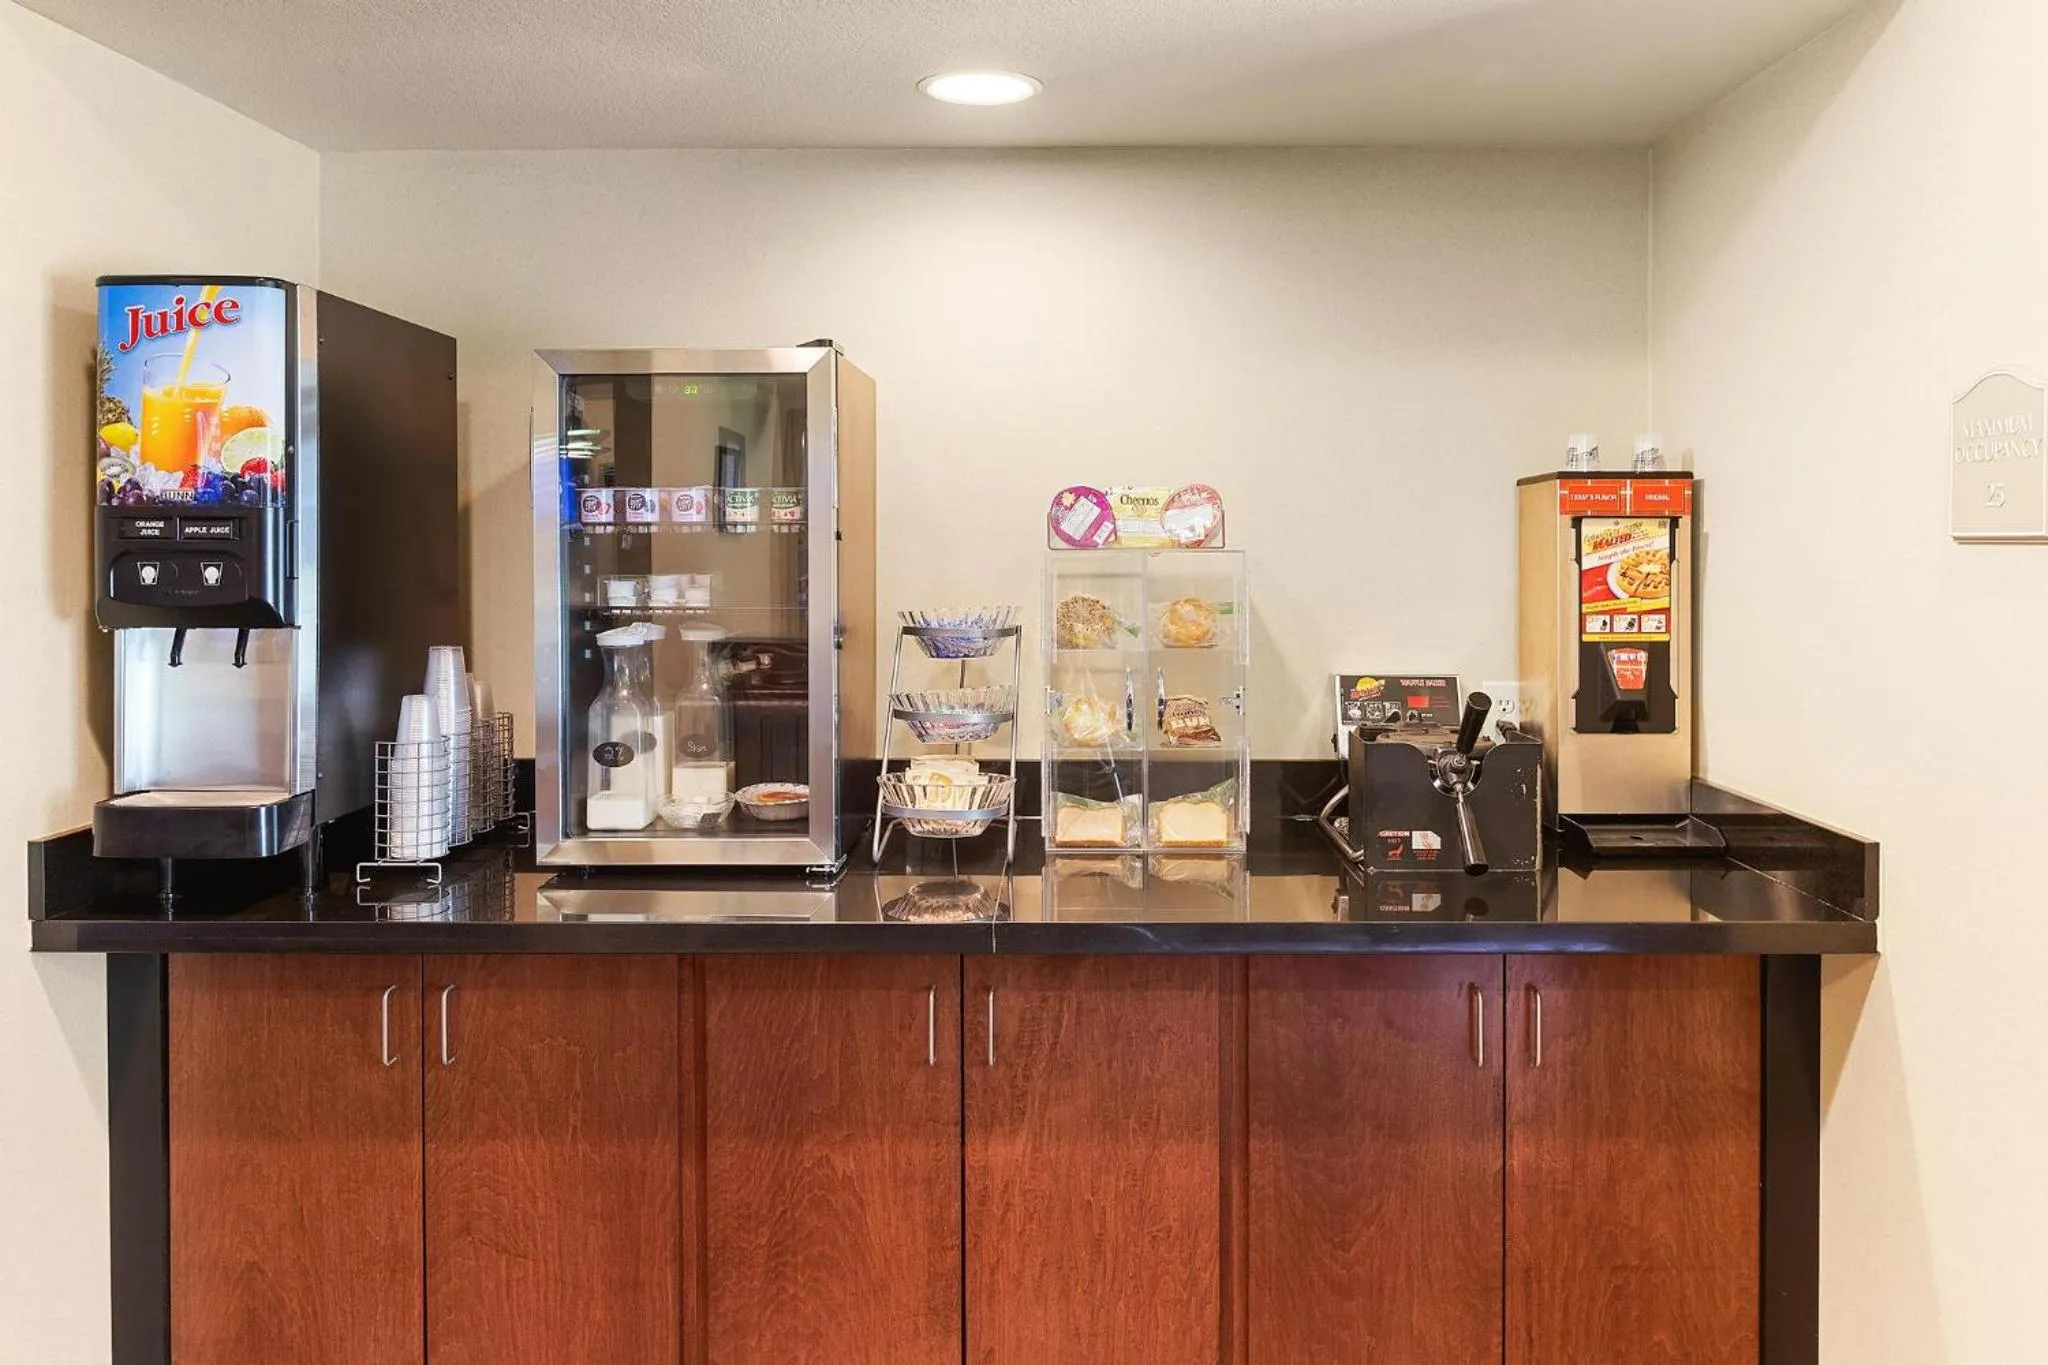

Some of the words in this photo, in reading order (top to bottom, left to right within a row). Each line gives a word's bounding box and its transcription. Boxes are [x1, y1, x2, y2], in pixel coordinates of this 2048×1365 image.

[118, 295, 240, 351] Juice
[1962, 414, 2033, 438] MAXIMUM
[1954, 438, 2042, 464] OCCUPANCY
[1120, 494, 1159, 507] Cheerios
[1985, 481, 2007, 508] 25
